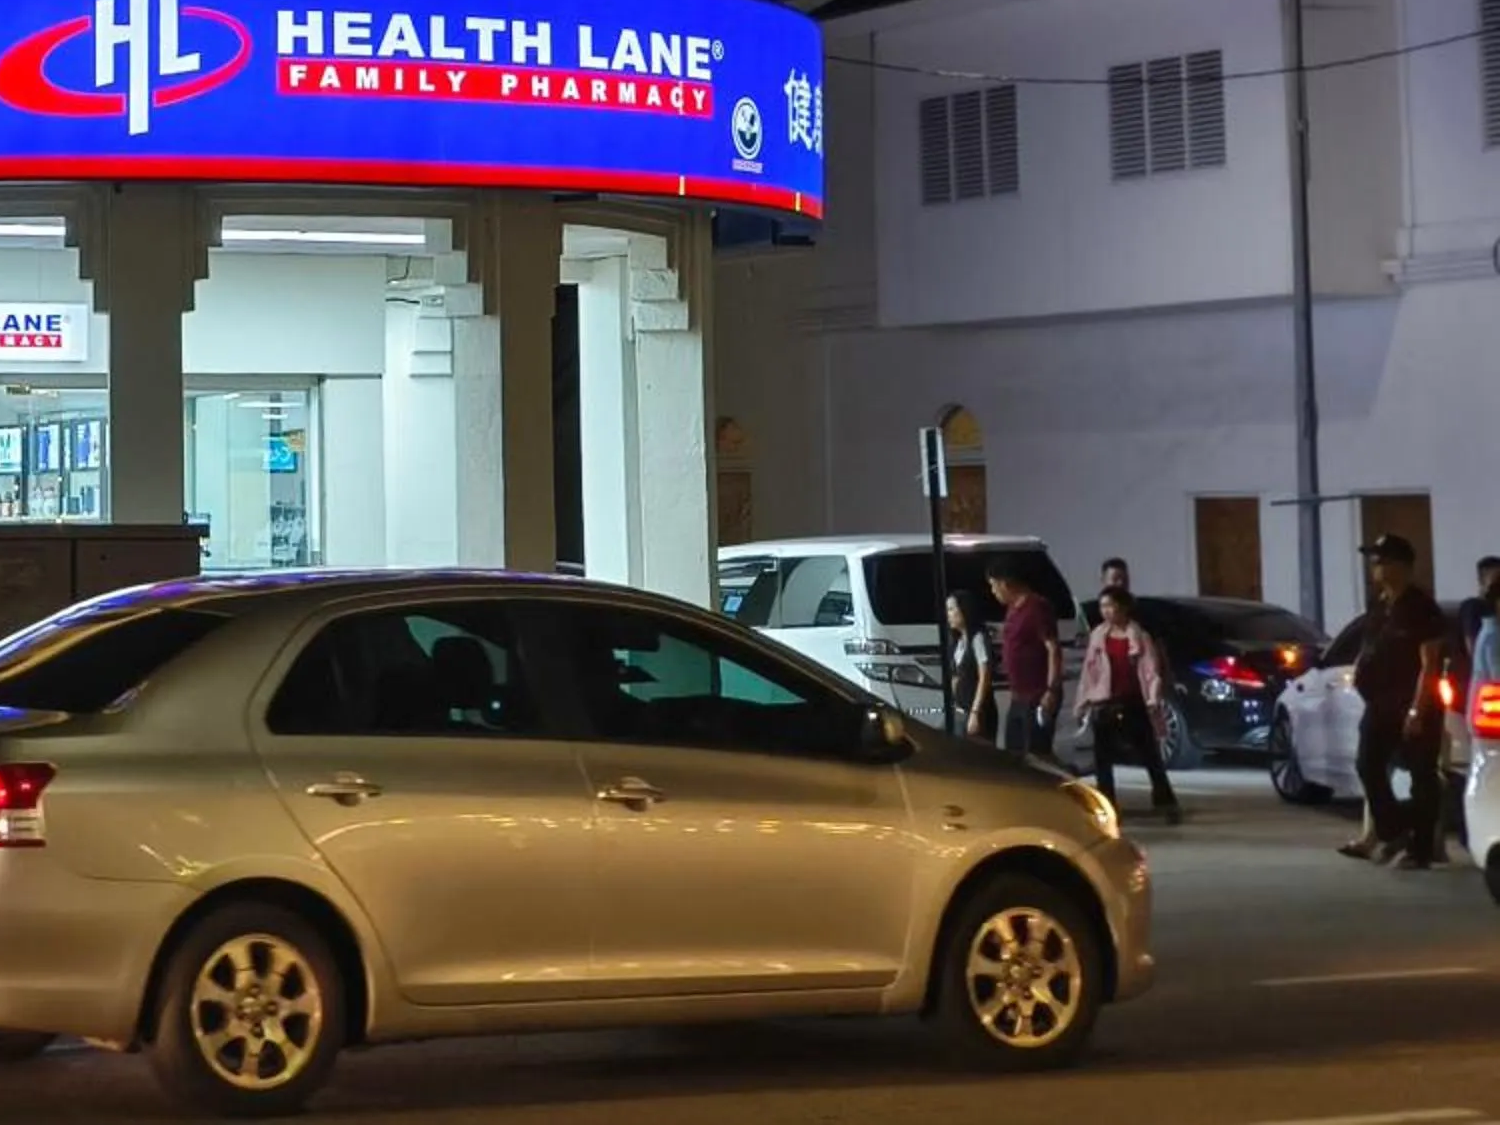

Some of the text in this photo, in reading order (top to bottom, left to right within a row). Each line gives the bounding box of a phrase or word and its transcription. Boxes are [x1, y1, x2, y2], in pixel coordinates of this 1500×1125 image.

[277, 10, 552, 65] HEALTH
[289, 64, 706, 114] FAMILY PHARMACY
